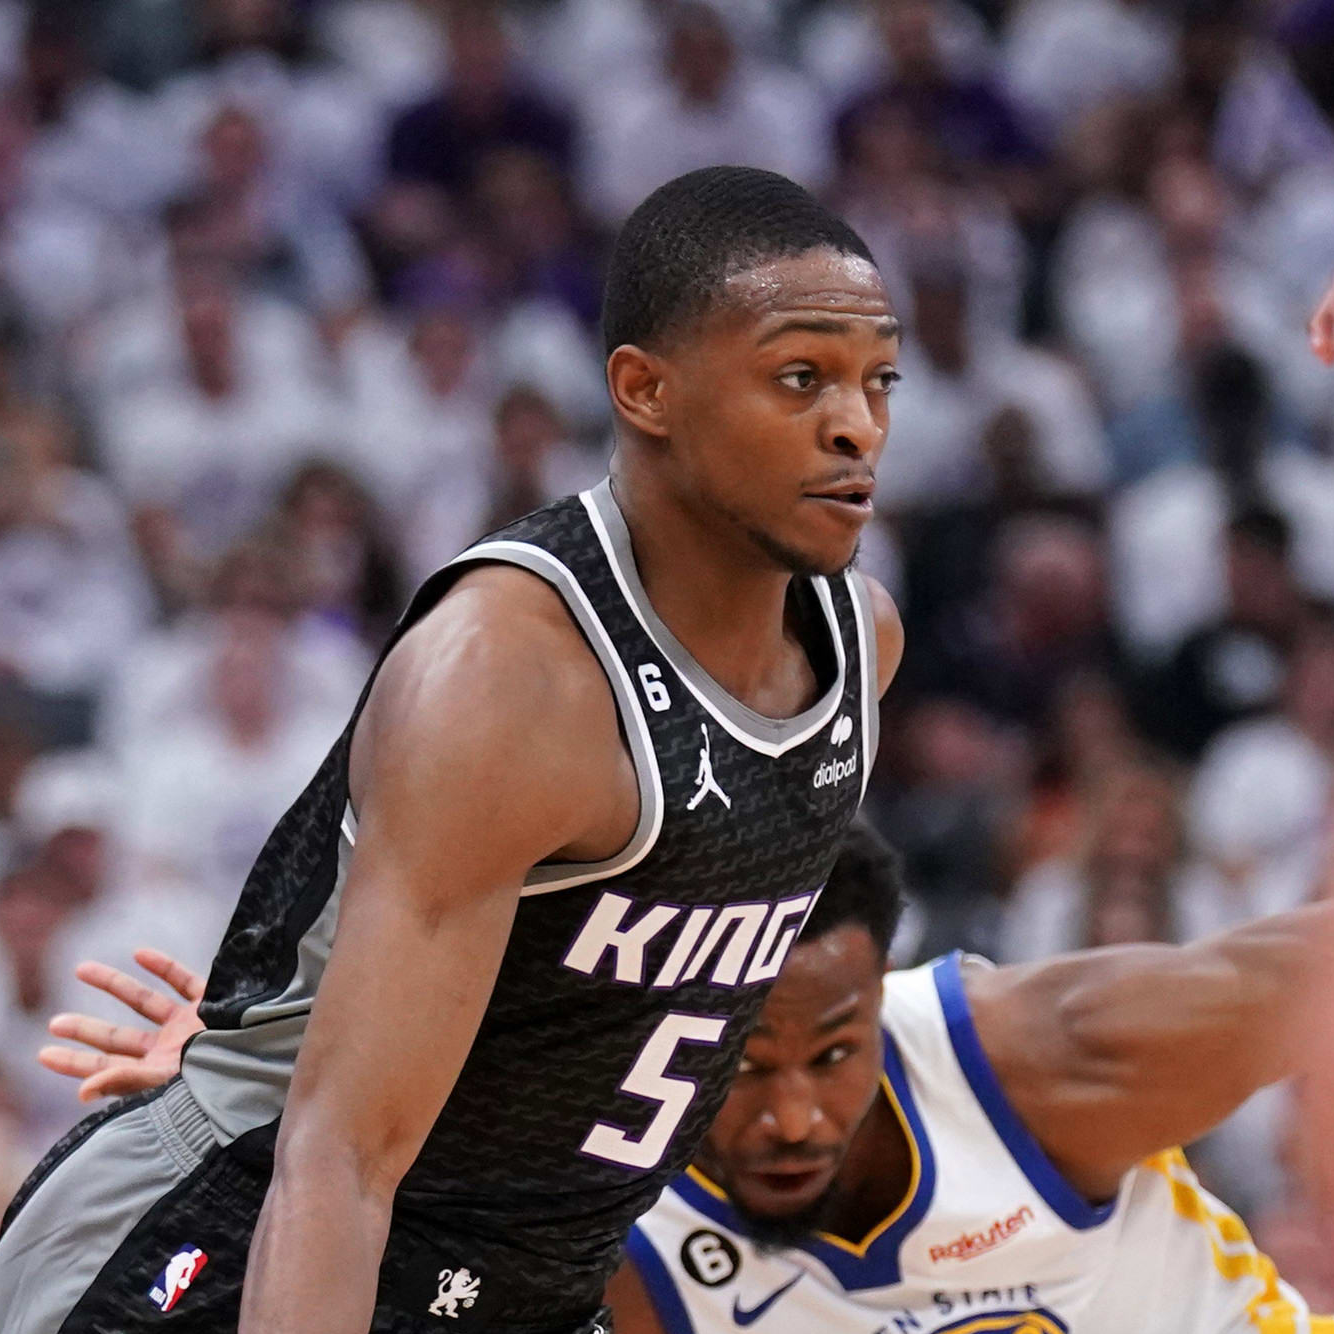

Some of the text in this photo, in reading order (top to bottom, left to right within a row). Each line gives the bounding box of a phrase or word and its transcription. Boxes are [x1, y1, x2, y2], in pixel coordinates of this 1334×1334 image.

[637, 662, 671, 712] 6
[813, 749, 858, 789] dialpad
[559, 886, 824, 990] KING
[575, 1009, 732, 1172] 5
[928, 1205, 1035, 1262] Rakuten
[687, 1236, 732, 1286] 6
